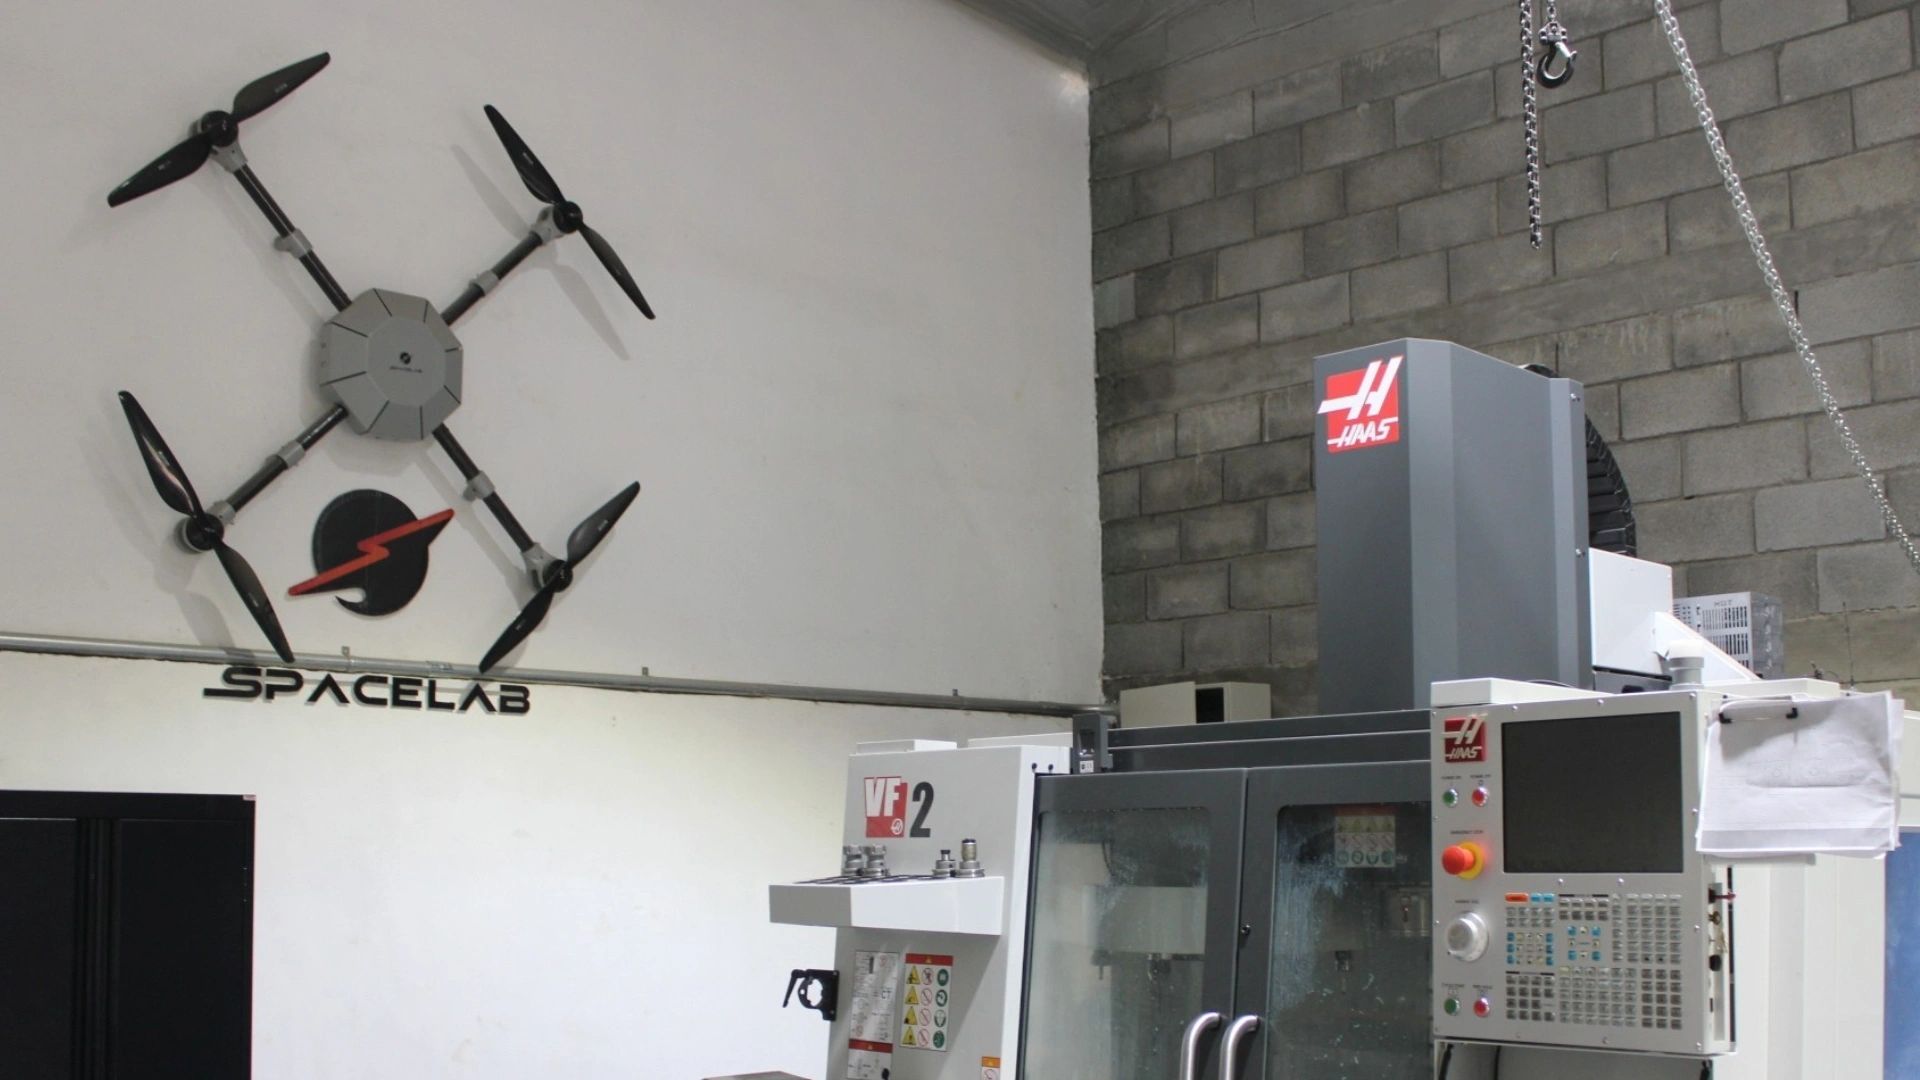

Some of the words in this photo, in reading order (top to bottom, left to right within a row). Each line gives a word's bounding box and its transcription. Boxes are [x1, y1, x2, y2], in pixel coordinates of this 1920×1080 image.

[1327, 416, 1399, 448] HAAS
[203, 666, 531, 714] SPACELAB
[1444, 746, 1483, 760] HAAS
[863, 776, 902, 818] VF
[909, 781, 934, 838] 2
